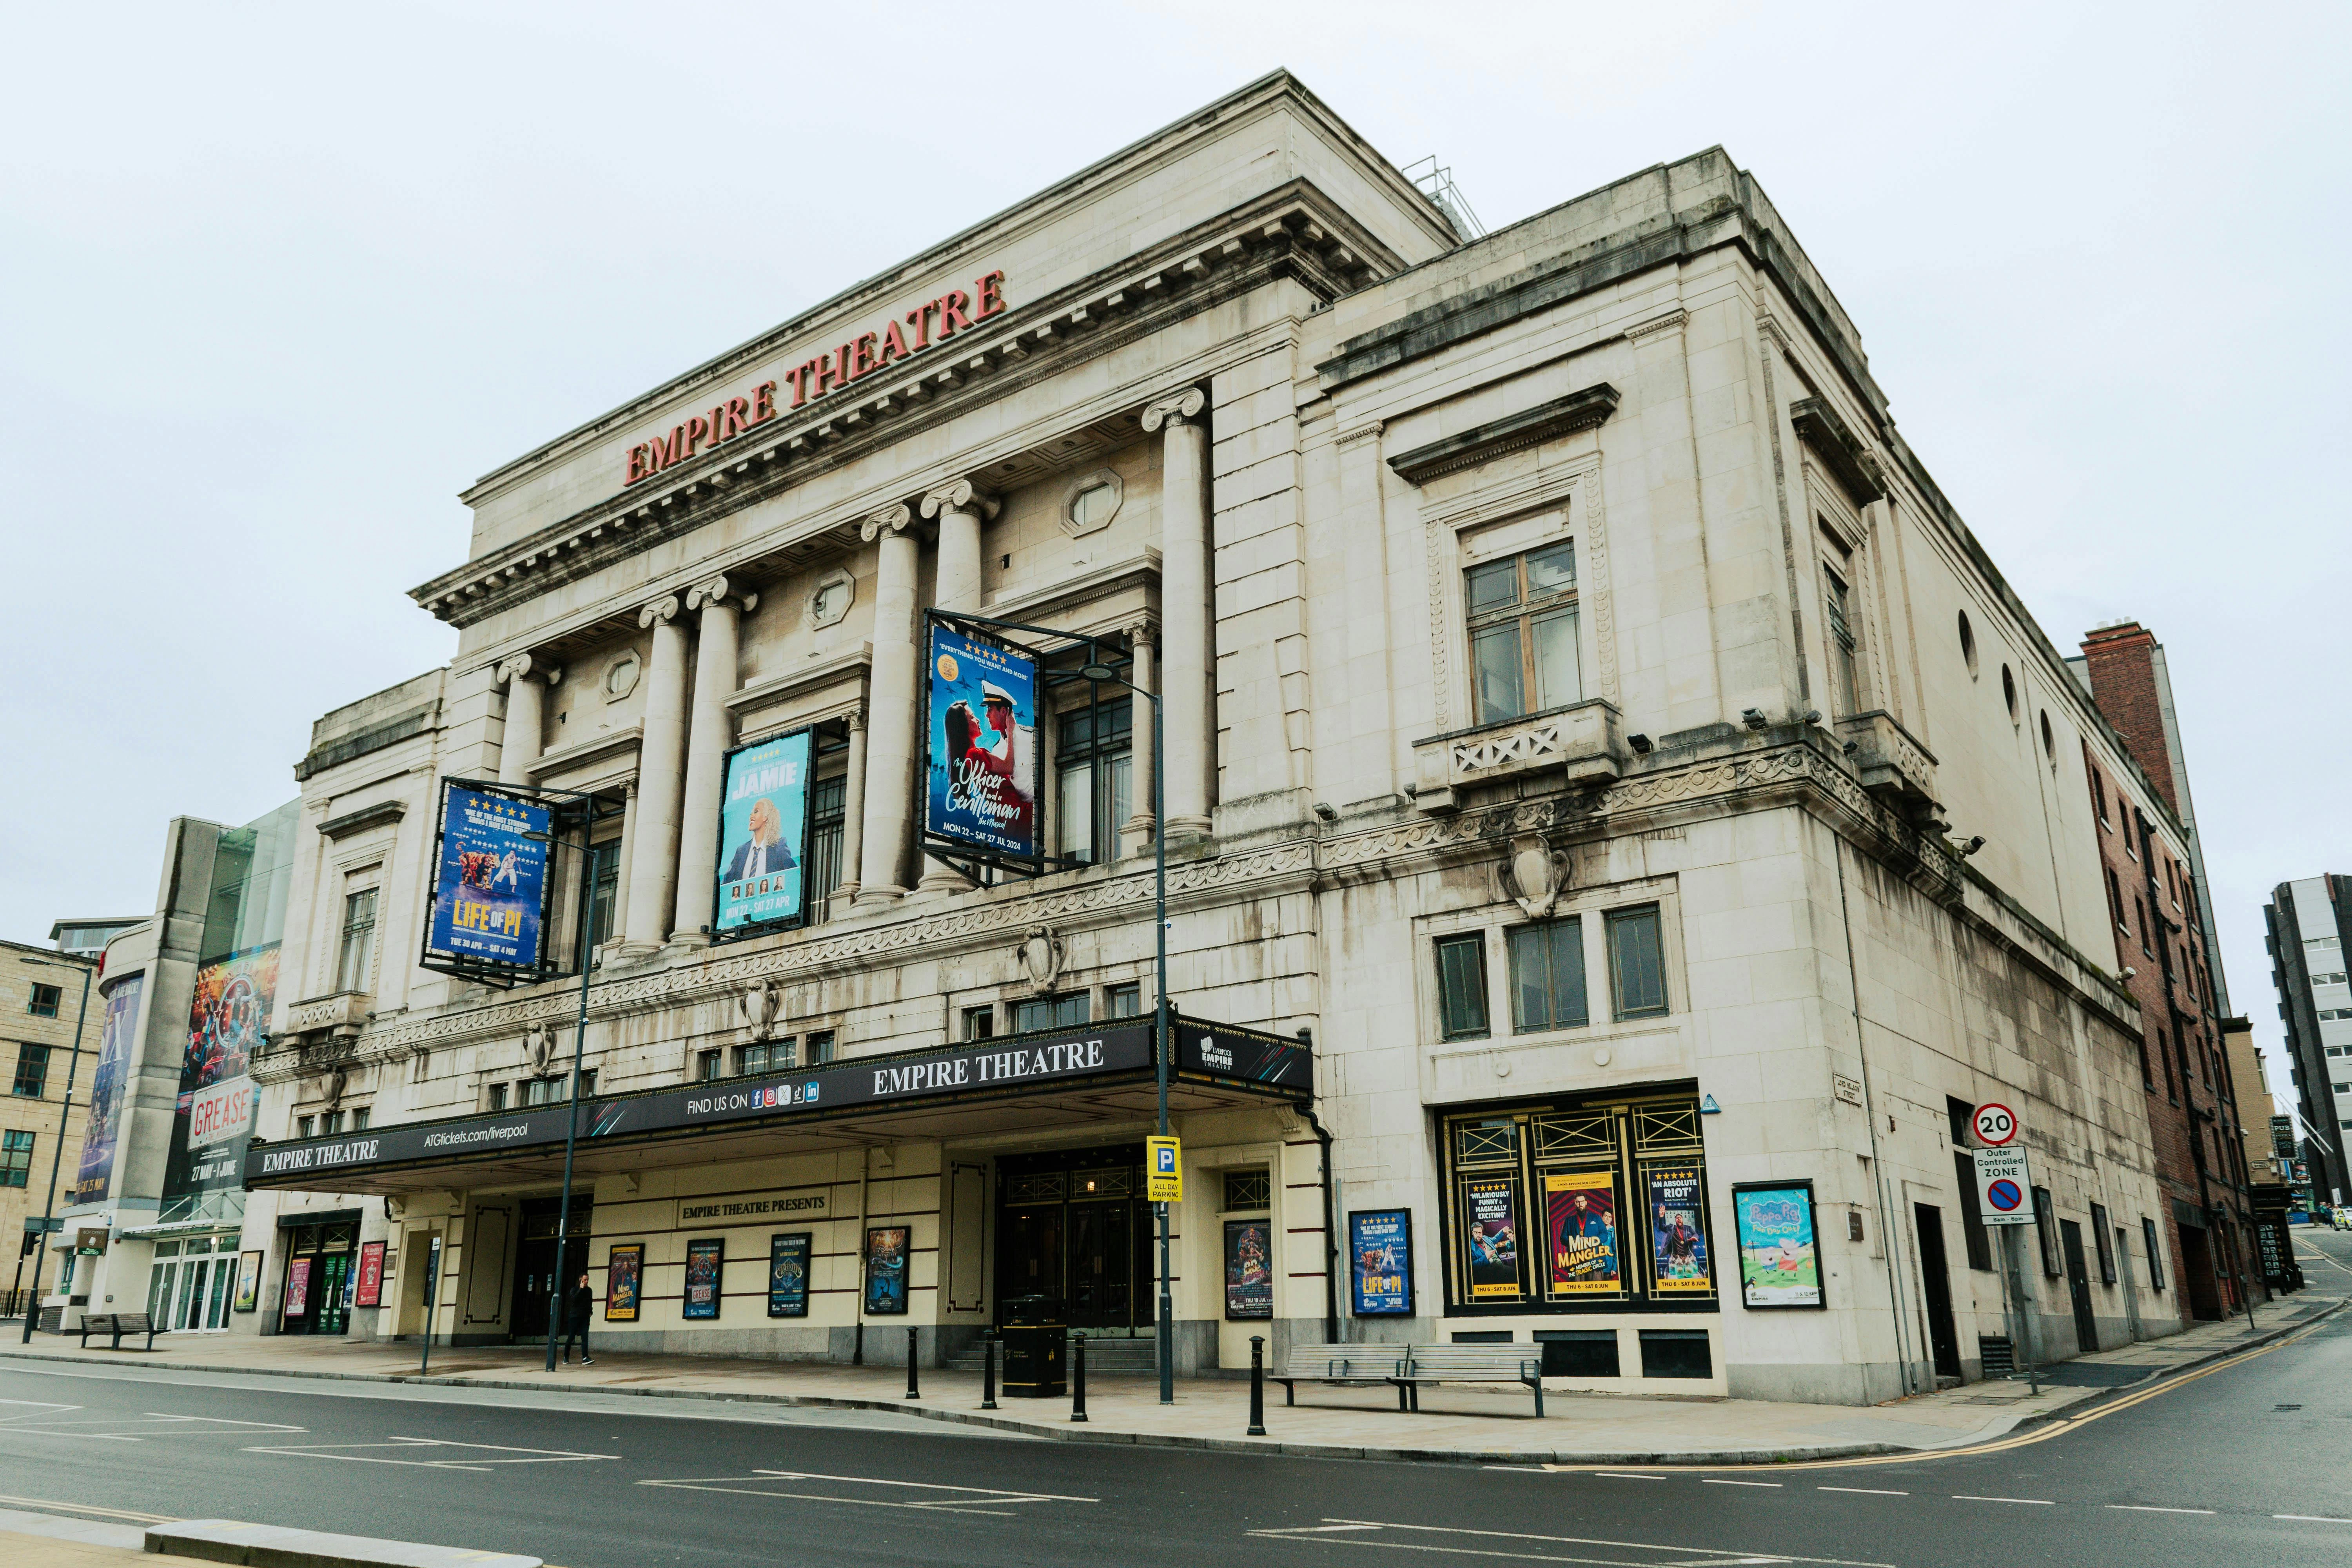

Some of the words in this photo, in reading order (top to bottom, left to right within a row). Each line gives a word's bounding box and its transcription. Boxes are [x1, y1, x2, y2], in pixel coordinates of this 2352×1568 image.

[623, 380, 776, 487] EMPIRE
[785, 269, 1007, 409] THEATRE
[974, 656, 985, 664] YOU
[986, 661, 1002, 670] WANT
[953, 757, 962, 767] An
[732, 762, 797, 800] JAMIE
[960, 758, 1005, 796] Officer
[946, 782, 1020, 820] Gentleman
[986, 791, 998, 801] and
[987, 818, 1007, 830] Musical
[943, 822, 960, 833] MON
[962, 827, 969, 836] 22
[975, 831, 986, 840] SAT
[997, 837, 1005, 846] JUL
[1007, 840, 1020, 850] 2024
[726, 906, 739, 919] MON
[740, 904, 748, 915] 22
[754, 900, 765, 913] SAT
[766, 898, 774, 910] 27
[775, 896, 790, 909] APR
[453, 899, 491, 931] LIFE
[490, 911, 505, 928] OF
[504, 909, 521, 936] PI
[450, 937, 462, 946] TUE
[462, 939, 470, 947] 30
[470, 941, 482, 950] APR
[490, 944, 501, 953] SAT
[505, 947, 517, 956] MAY
[1202, 1052, 1232, 1065] EMPIRE
[1213, 1046, 1232, 1056] LIVERPOOL
[873, 1059, 969, 1095] EMPIRE
[976, 1040, 1103, 1082] THEATRE
[1205, 1061, 1230, 1070] THEATRE
[195, 1088, 249, 1136] GREASE
[687, 1098, 711, 1115] FIND
[714, 1095, 727, 1112] US
[730, 1093, 748, 1109] ON
[1980, 1115, 2010, 1133] 20
[424, 1122, 528, 1148] ATGtickets.com/liverpool
[263, 1148, 313, 1172] EMPIRE
[315, 1140, 379, 1166] THEATRE
[1160, 1151, 1172, 1169] P
[1978, 1158, 2024, 1166] Controlled
[191, 1166, 200, 1181] 27
[199, 1163, 214, 1180] MAY
[220, 1160, 237, 1177] JUNE
[1985, 1168, 2018, 1177] ZONE
[1663, 1179, 1697, 1187] ABSOLUTE
[1470, 1191, 1509, 1199] 'HILARIOUSLY
[1664, 1187, 1692, 1198] RIOT'
[682, 1205, 720, 1219] EMPIRE
[722, 1201, 769, 1216] THEATRE
[771, 1196, 824, 1212] PRESENTS
[1752, 1206, 1782, 1224] Peppa
[1782, 1204, 1799, 1221] Pig
[1782, 1225, 1800, 1234] Out!
[1569, 1235, 1600, 1252] MIND
[1558, 1245, 1613, 1268] MANGLER
[1575, 1266, 1592, 1276] TRAGIC
[1576, 1261, 1591, 1270] MEMBER
[618, 1284, 630, 1294] MIND
[1363, 1277, 1383, 1293] LIFE
[1383, 1279, 1391, 1289] OF
[1391, 1276, 1401, 1293] PI
[612, 1290, 633, 1302] MANGLER
[693, 1288, 710, 1299] GREASE
